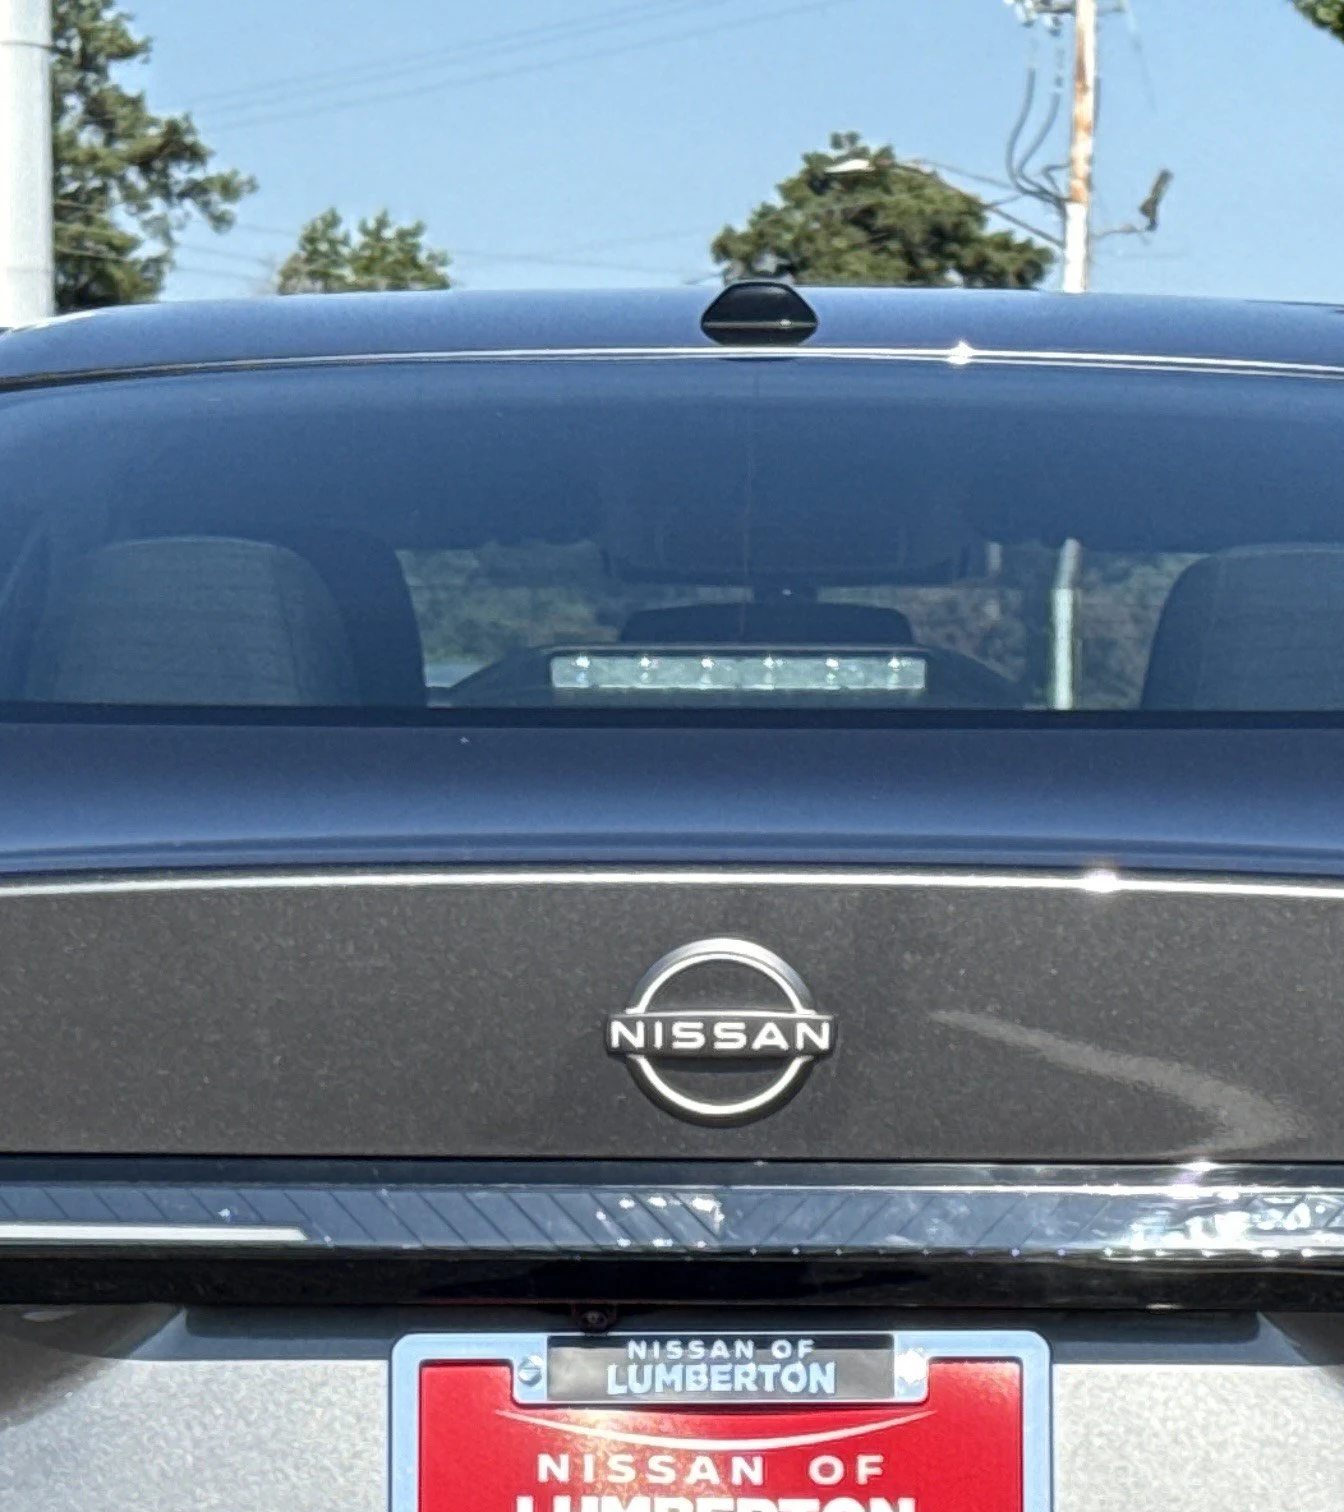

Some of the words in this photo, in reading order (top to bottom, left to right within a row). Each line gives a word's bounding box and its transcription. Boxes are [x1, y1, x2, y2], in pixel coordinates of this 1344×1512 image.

[609, 1020, 831, 1051] NISSAN
[627, 1338, 755, 1360] NISSAN
[770, 1338, 816, 1360] OF
[607, 1361, 836, 1395] LUMBERTON
[537, 1453, 765, 1487] NISSAN
[808, 1452, 885, 1486] OF
